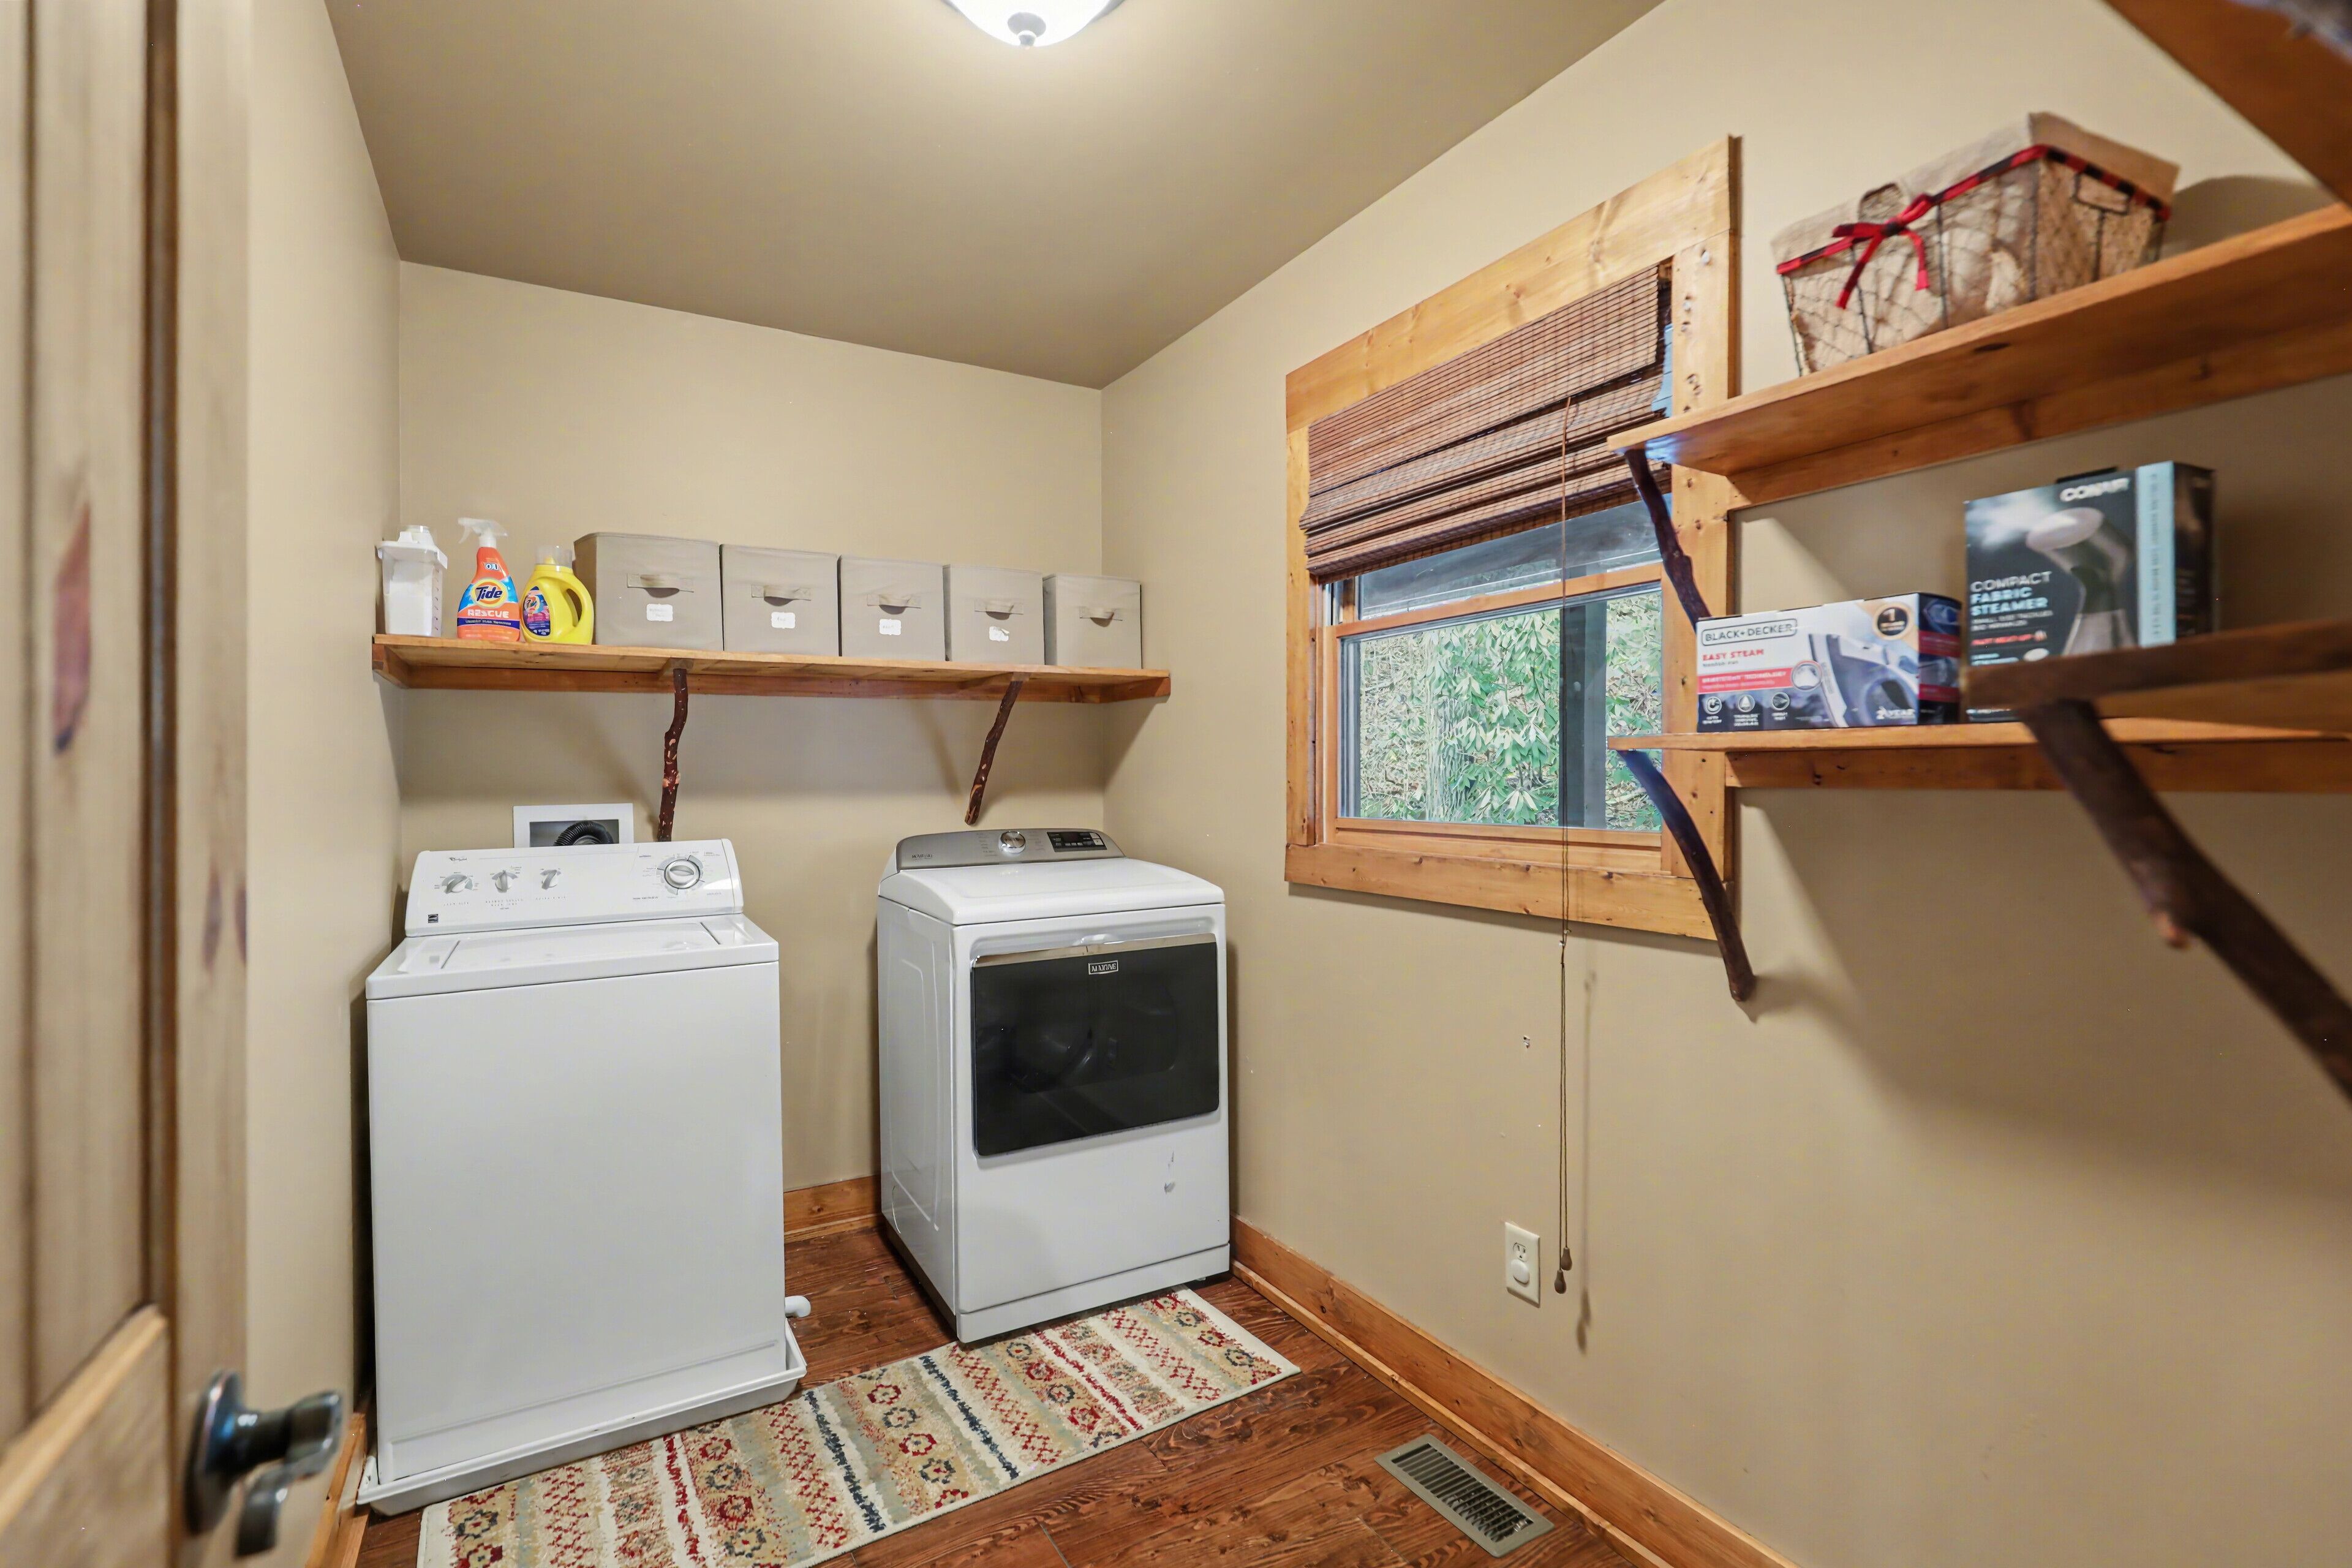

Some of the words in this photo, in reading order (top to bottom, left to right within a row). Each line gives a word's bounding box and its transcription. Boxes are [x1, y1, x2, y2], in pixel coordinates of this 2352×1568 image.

[1970, 571, 2052, 593] COMPACT
[475, 586, 503, 601] Tide
[1970, 587, 2032, 605] FABRIC
[467, 609, 509, 619] RESCUE
[1971, 597, 2049, 616] STEAMER
[1730, 649, 1765, 658] STEAM
